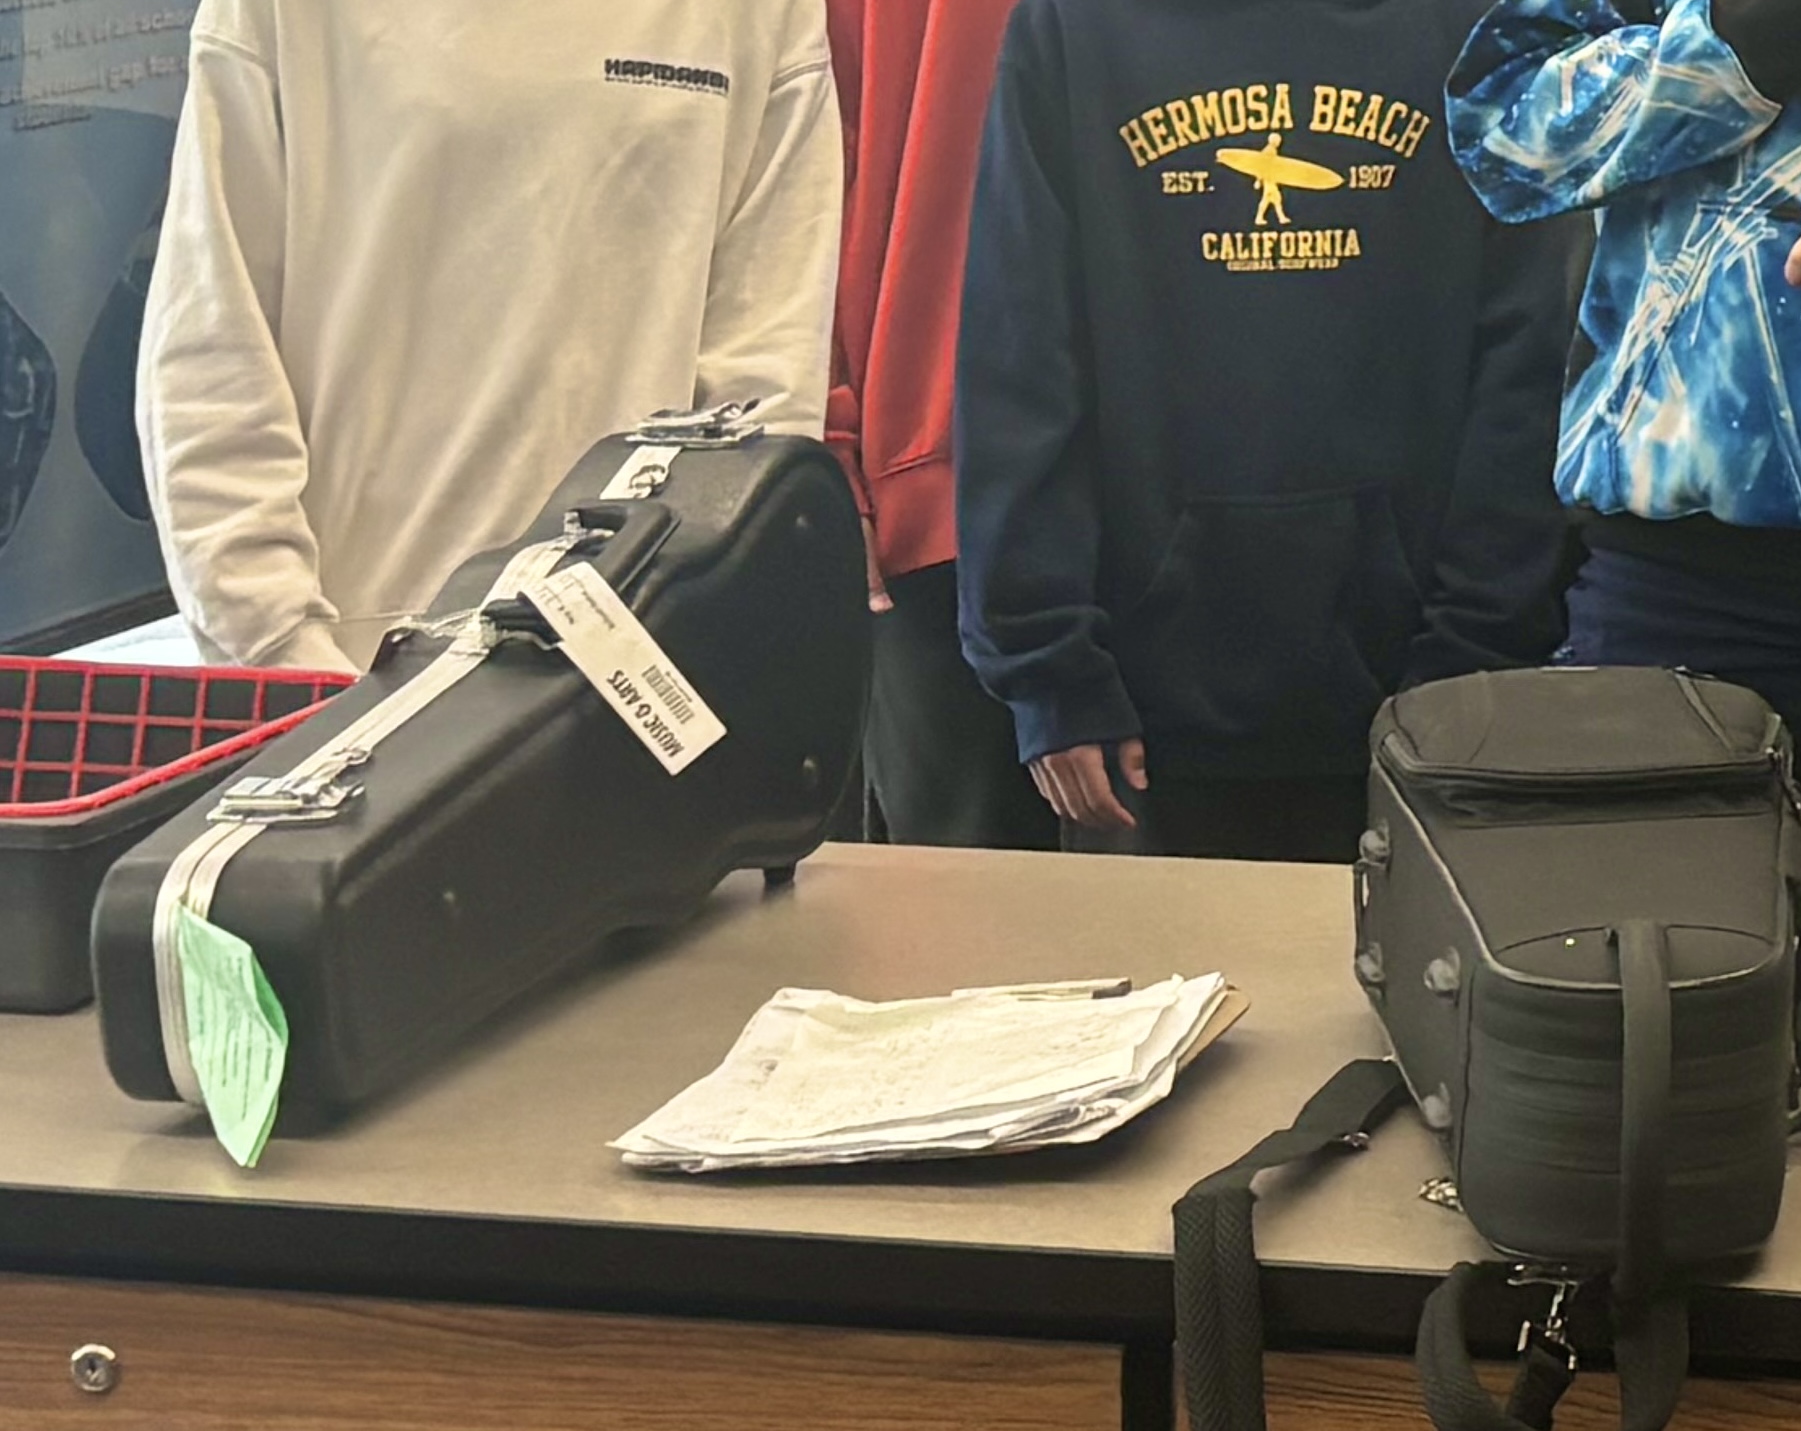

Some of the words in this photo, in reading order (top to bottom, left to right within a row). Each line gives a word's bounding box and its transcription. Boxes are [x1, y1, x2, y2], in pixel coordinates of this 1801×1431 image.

[1119, 83, 1293, 168] HERMOSA
[1309, 85, 1430, 158] BEACH
[1161, 172, 1215, 193] EST.
[1202, 228, 1361, 260] CALIFORNIA
[606, 669, 642, 706] ARTS
[643, 713, 686, 758] MUSIC
